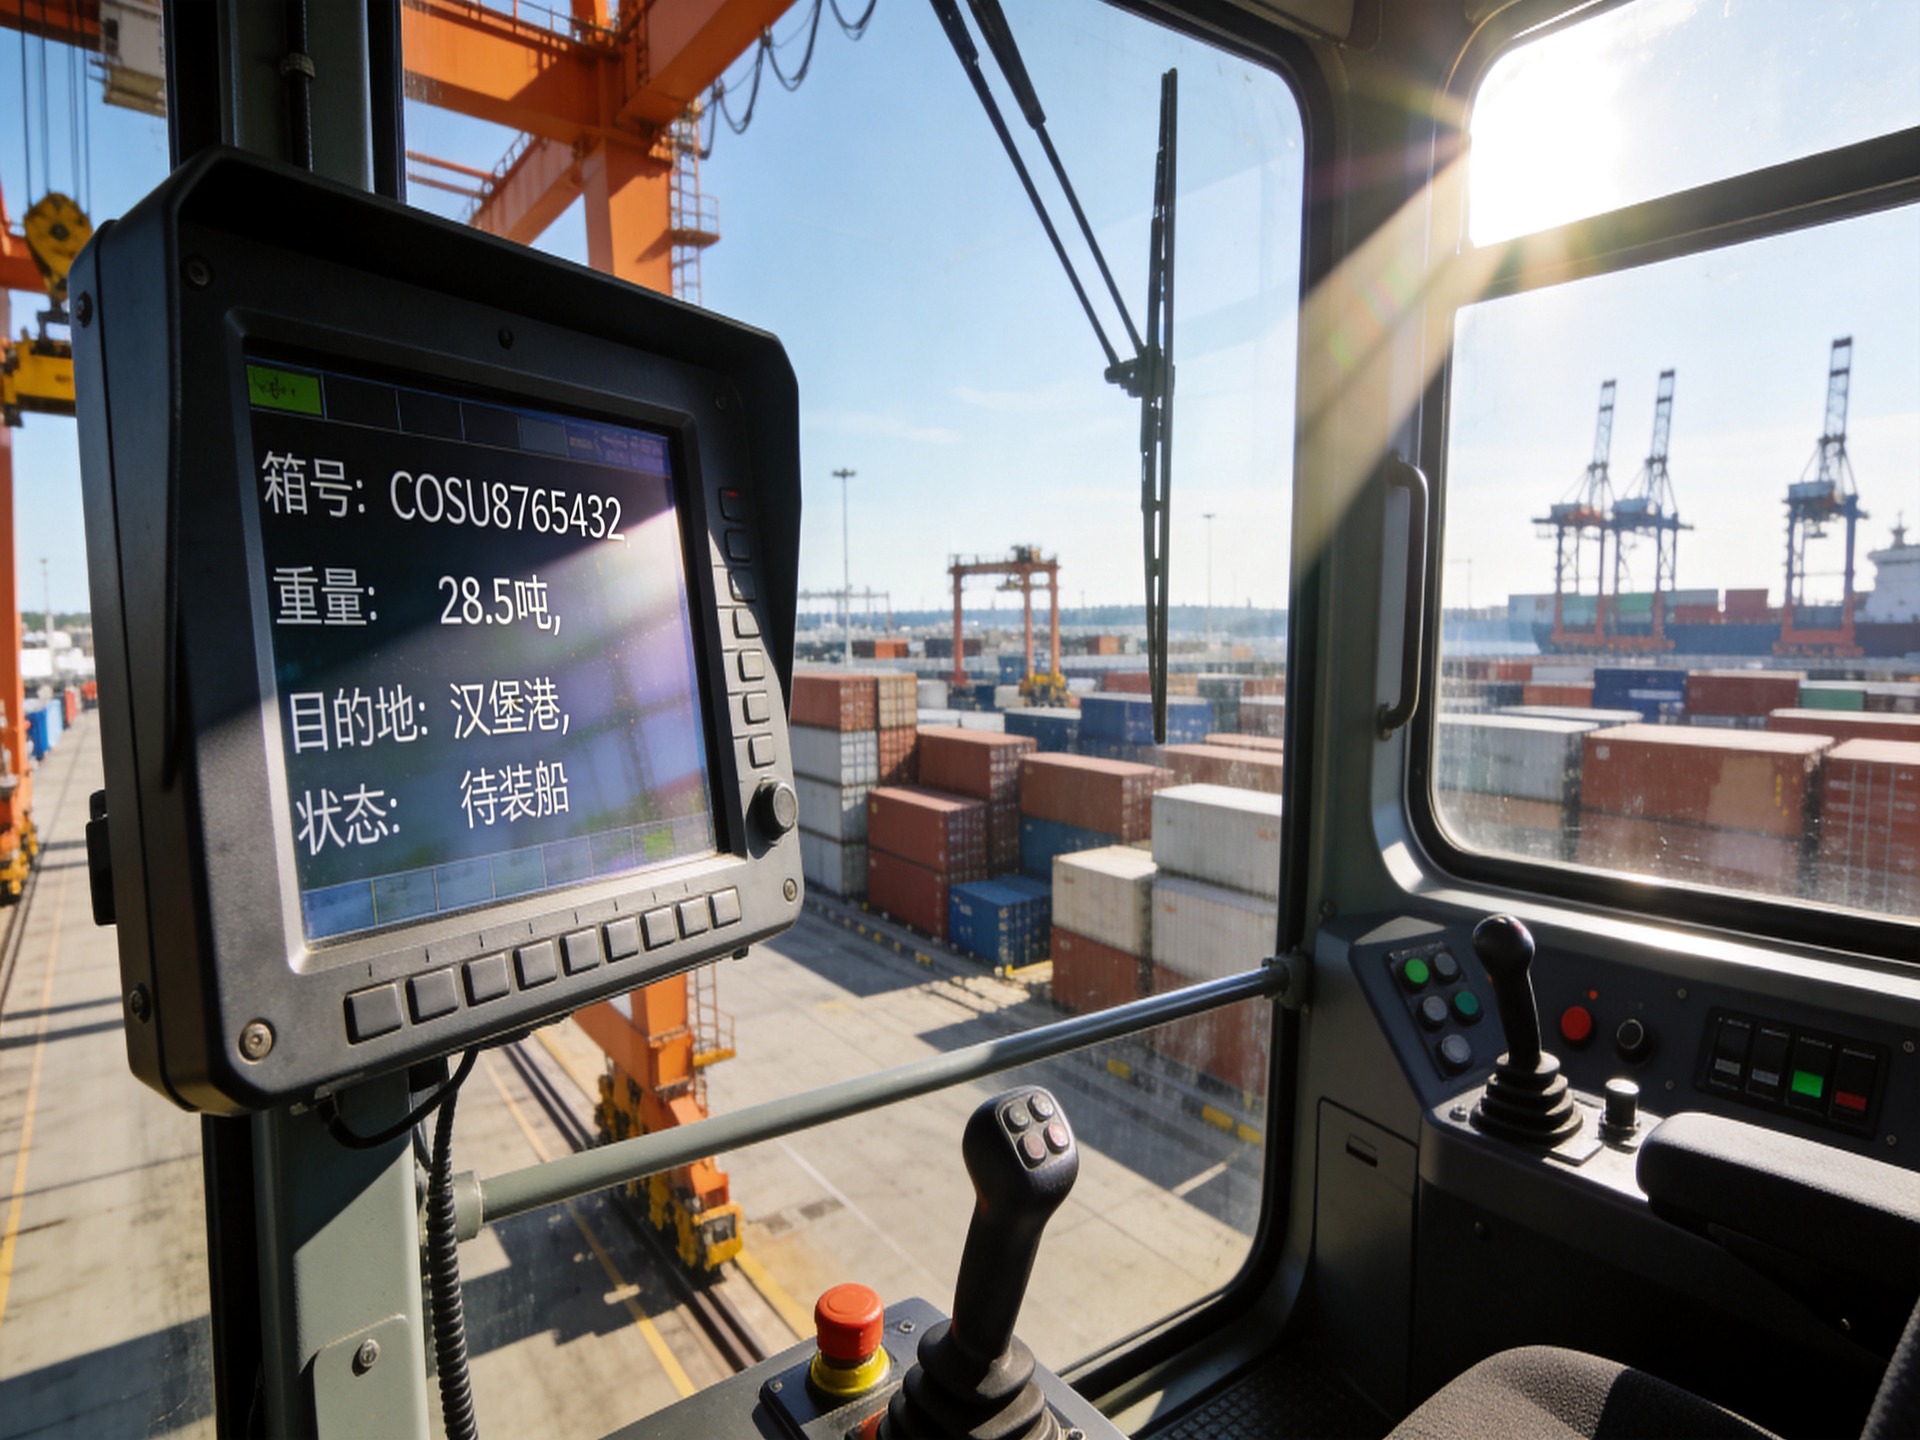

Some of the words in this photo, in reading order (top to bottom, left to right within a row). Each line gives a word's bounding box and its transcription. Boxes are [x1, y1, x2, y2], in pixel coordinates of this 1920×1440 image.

[262, 451, 365, 517] 箱号:
[273, 566, 377, 625] 重量:
[438, 574, 561, 637] 28.5吨,
[290, 683, 429, 754] 目的地:
[450, 676, 570, 740] 汉堡港,
[296, 783, 401, 855] 状态:
[460, 760, 570, 829] 待装船
